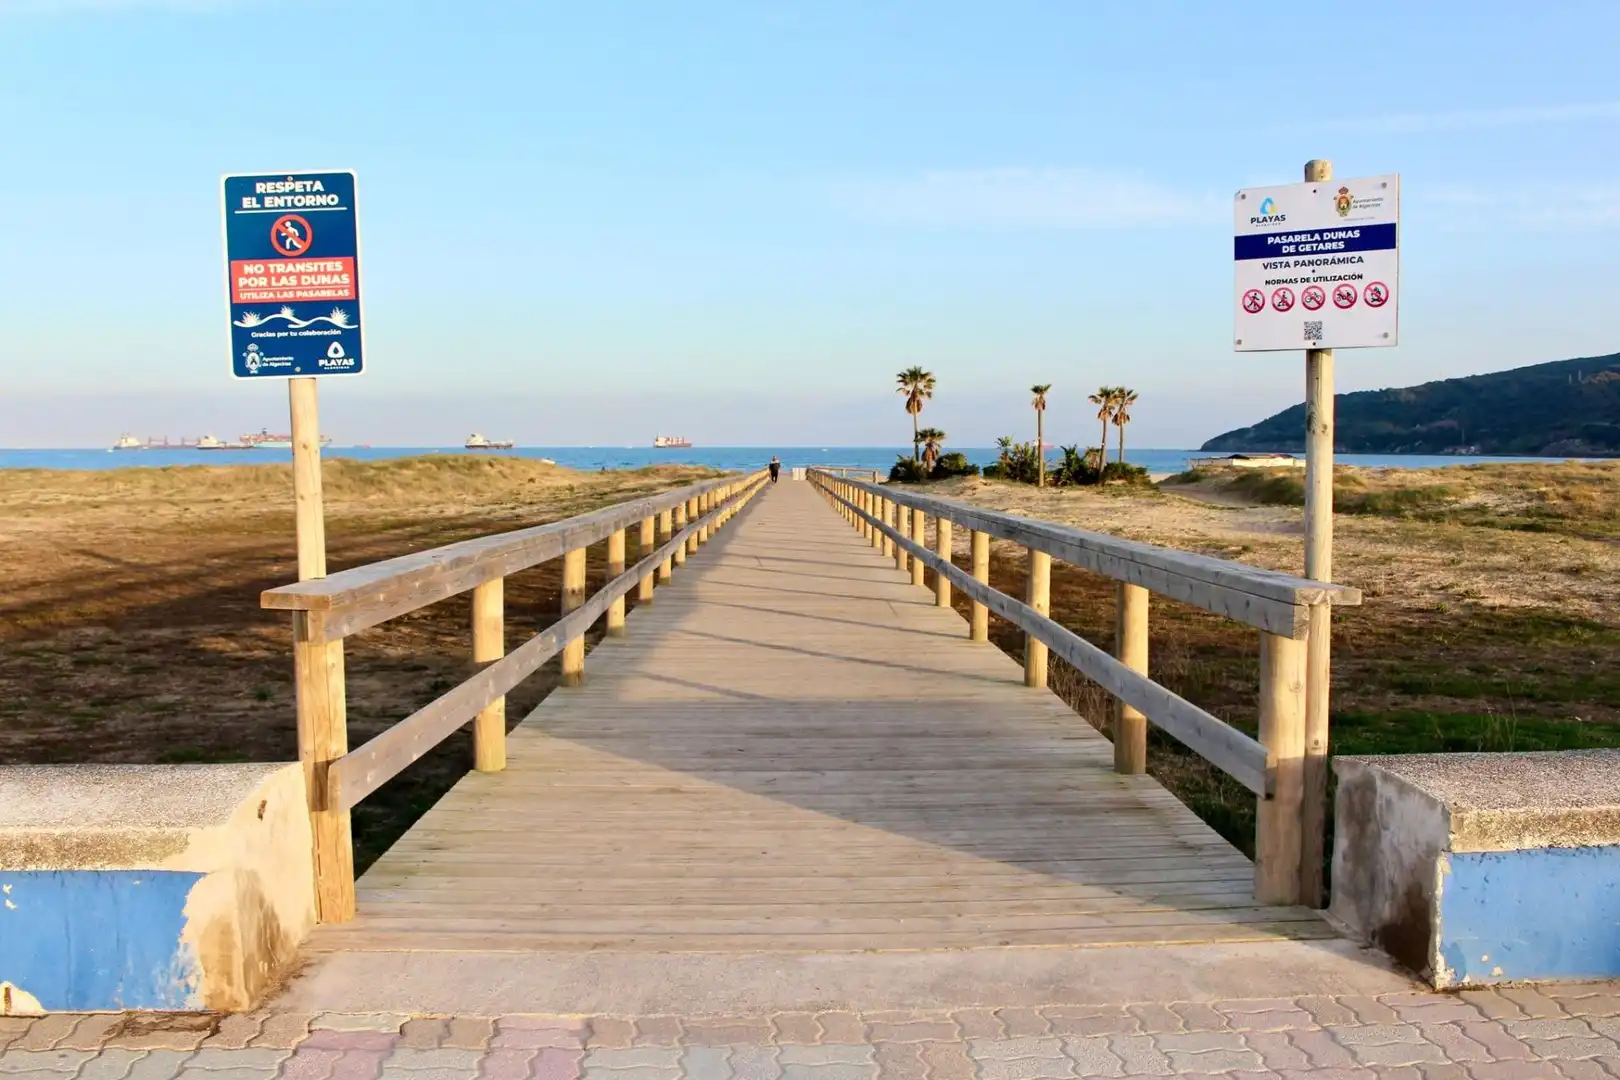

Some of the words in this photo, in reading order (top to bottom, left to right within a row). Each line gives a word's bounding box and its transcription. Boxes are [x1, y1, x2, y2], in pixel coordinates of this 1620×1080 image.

[255, 181, 325, 194] RESPETA
[242, 197, 261, 208] EL
[264, 194, 339, 207] ENTORNO
[1250, 214, 1286, 224] PLAYAS
[1267, 233, 1321, 245] PASARELA
[1323, 230, 1360, 240] DUNAS
[1282, 245, 1296, 254] DE
[1298, 241, 1345, 252] GETARES
[243, 263, 264, 274] NO
[267, 261, 343, 273] TRANSITES
[1262, 260, 1291, 270] VISTA
[1294, 256, 1364, 268] PANORÁMICA
[238, 276, 268, 287] POR
[271, 275, 298, 286] LAS
[301, 273, 350, 285] DUNAS
[1264, 278, 1299, 286] NORMAS
[1313, 273, 1363, 283] UTILIZACIÓN
[239, 291, 274, 299] UTILIZA
[276, 290, 295, 298] LAS
[296, 289, 350, 298] PASARELAS
[298, 329, 342, 337] colaboración
[318, 358, 355, 367] PLAYAS
